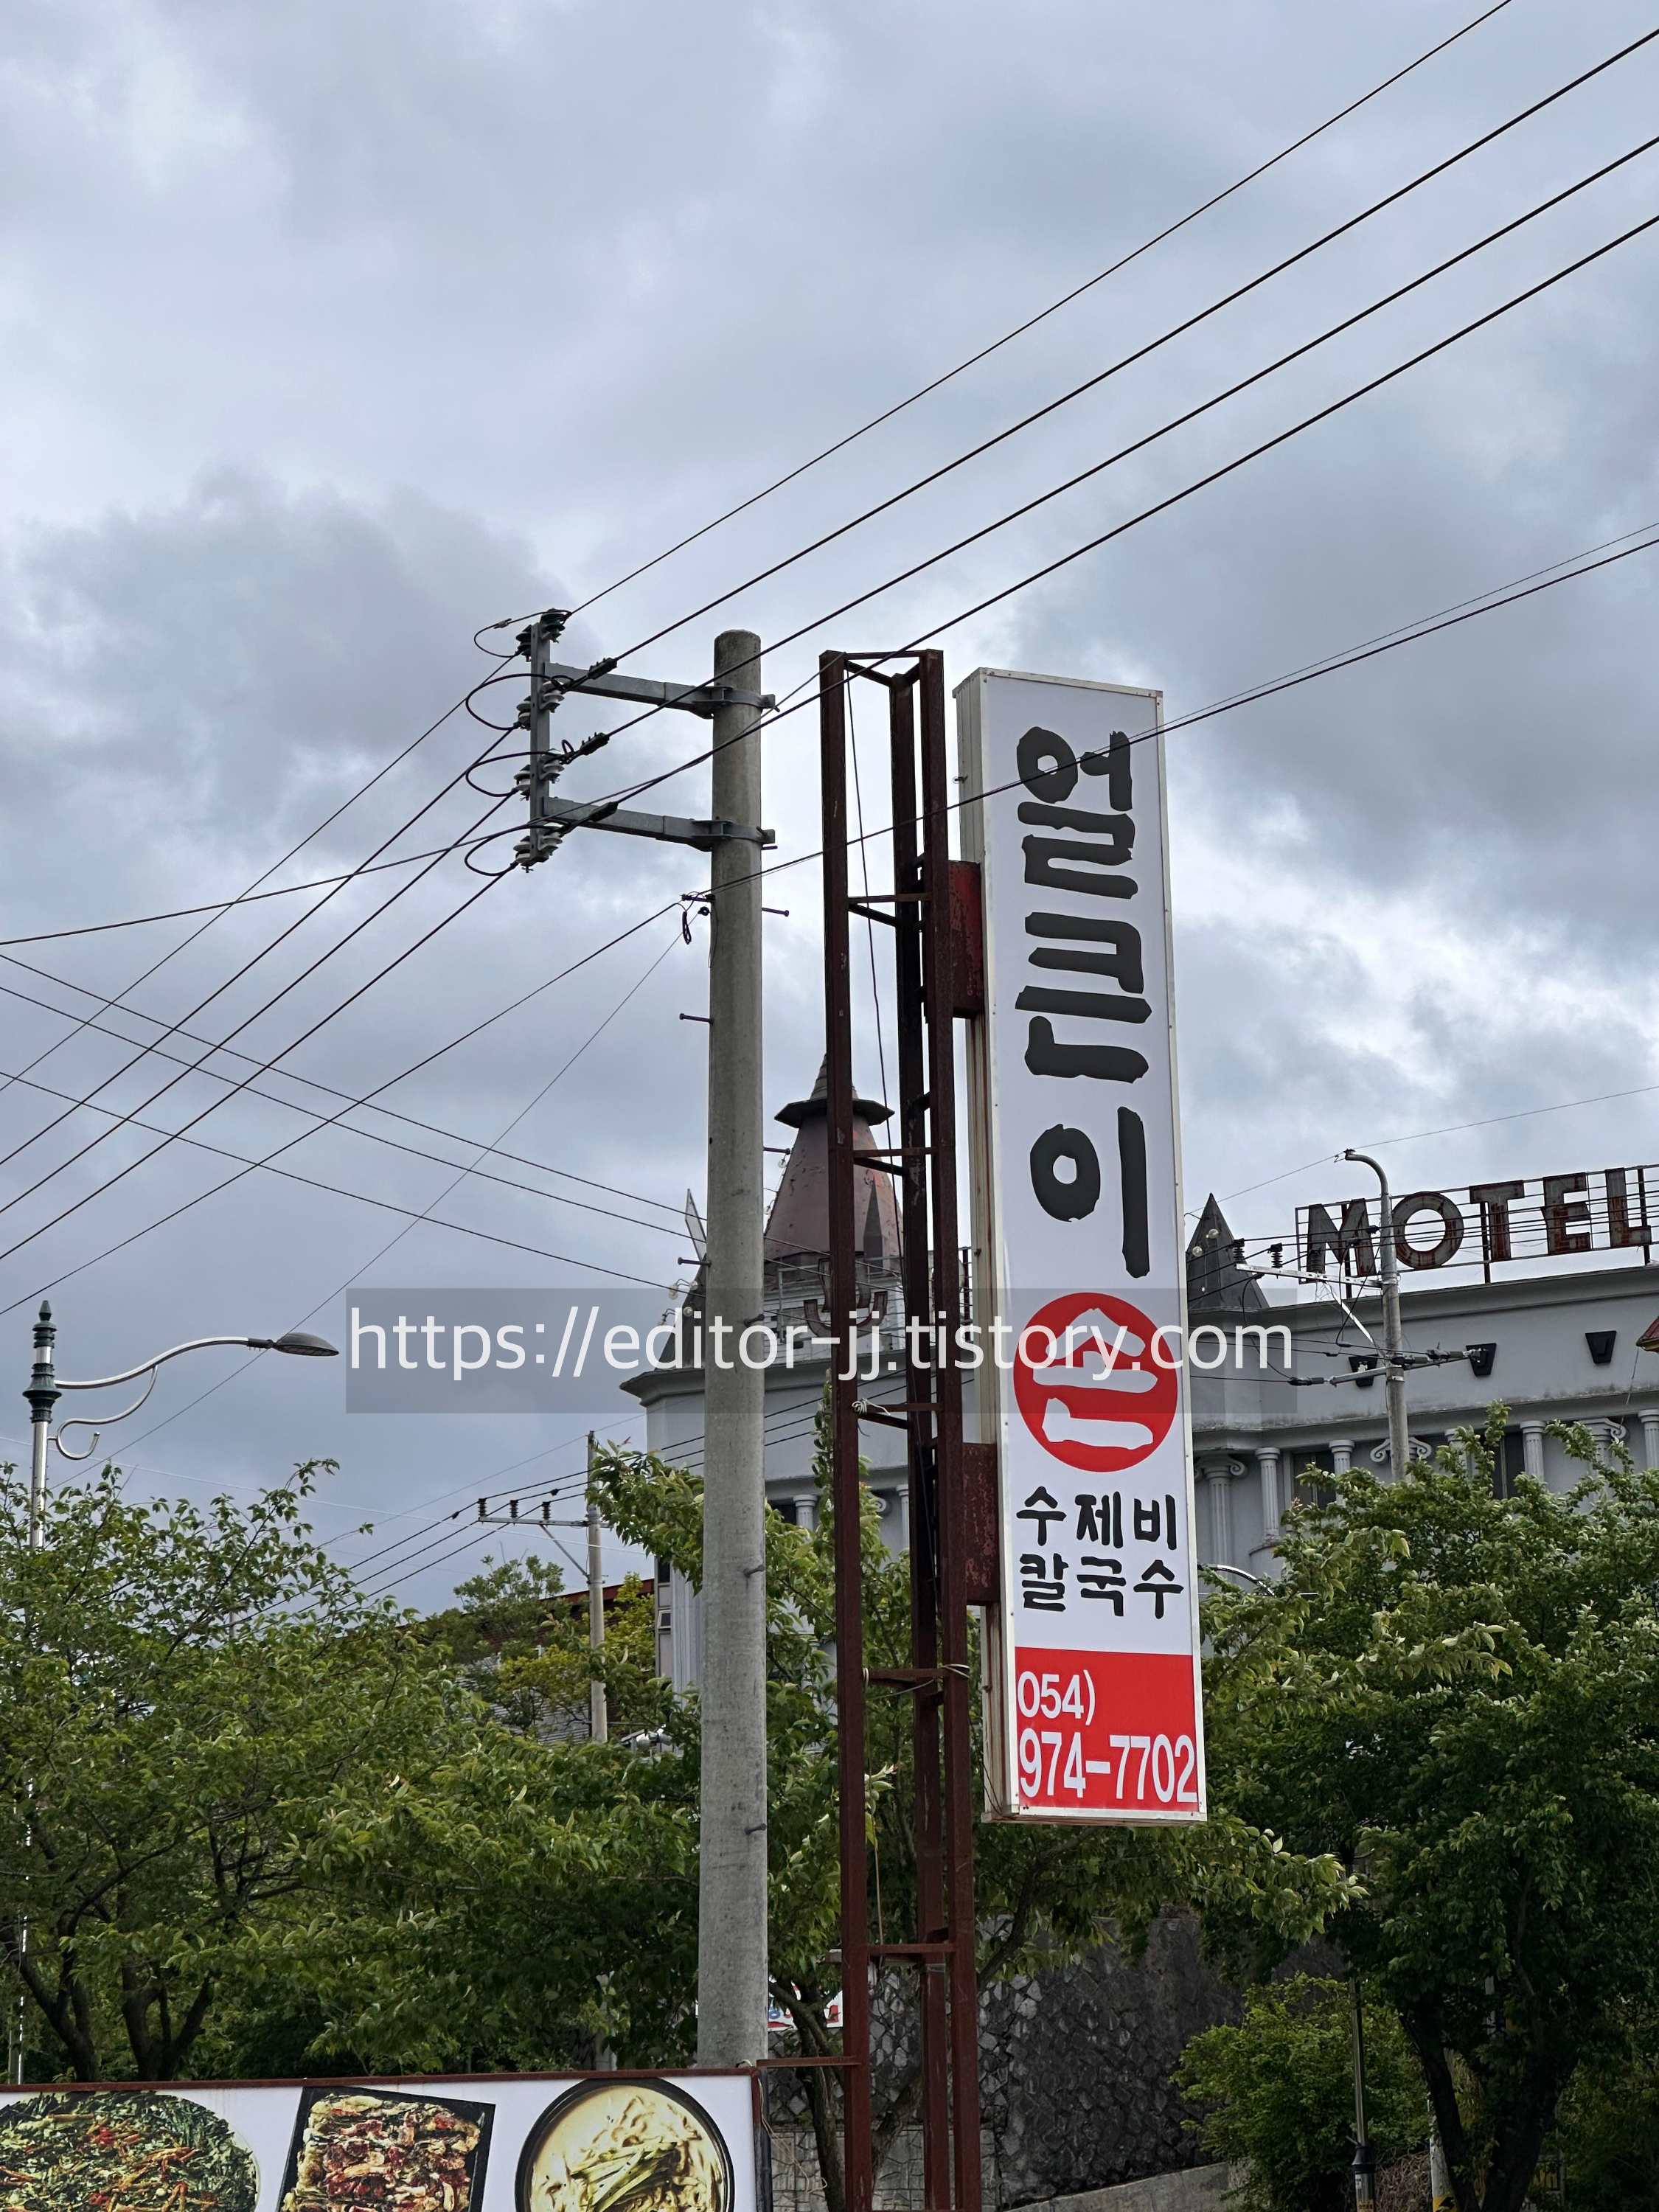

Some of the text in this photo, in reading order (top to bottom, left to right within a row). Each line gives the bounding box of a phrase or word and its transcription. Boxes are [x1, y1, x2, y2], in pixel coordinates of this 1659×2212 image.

[1016, 726, 1152, 1278] 얼큰이
[1307, 1167, 1652, 1277] MOTEL
[1033, 1308, 1158, 1450] 손
[1017, 1486, 1177, 1550] 수제비
[1020, 1553, 1184, 1619] 칼국수
[1018, 1669, 1096, 1726] 054)
[1019, 1731, 1197, 1804] 974-7702
